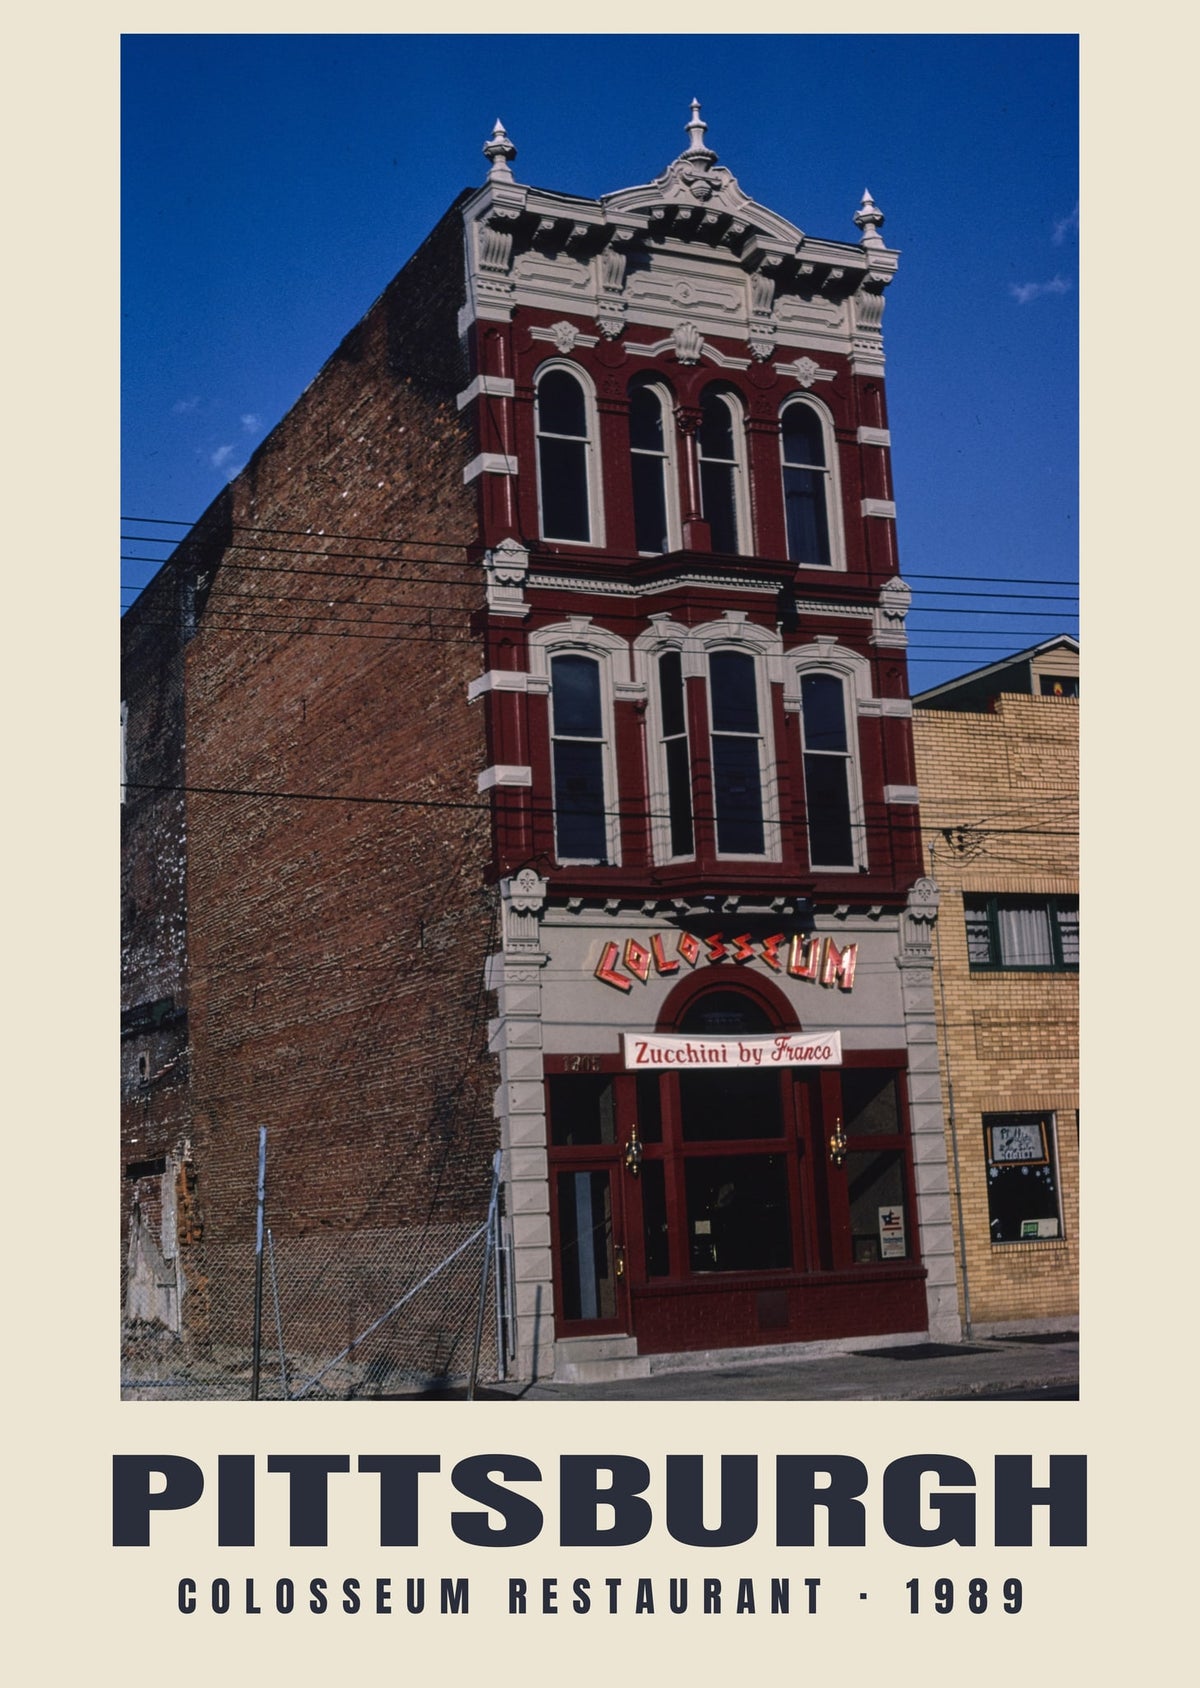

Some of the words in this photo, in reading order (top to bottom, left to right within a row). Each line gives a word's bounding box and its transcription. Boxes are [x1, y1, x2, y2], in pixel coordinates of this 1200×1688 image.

[594, 930, 859, 990] COLOSSEUM
[635, 1041, 728, 1065] Zucchini
[739, 1041, 763, 1066] by
[771, 1035, 833, 1062] Franco
